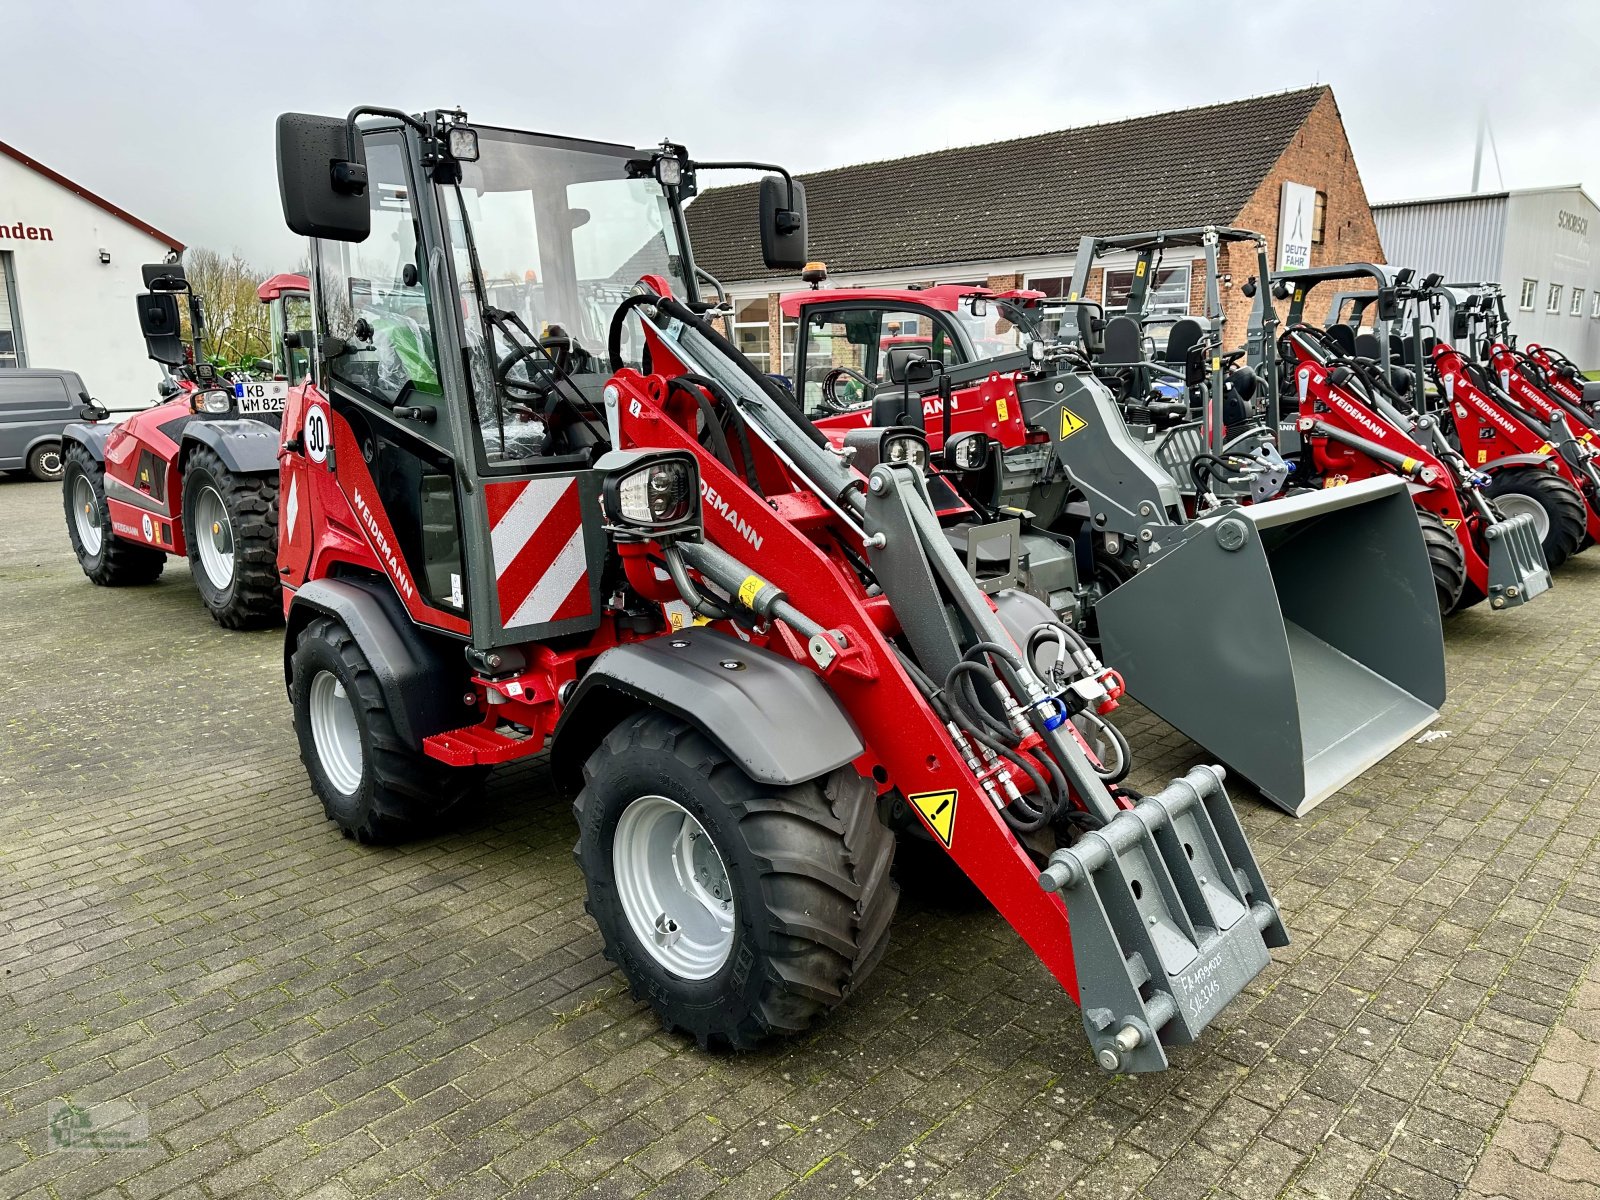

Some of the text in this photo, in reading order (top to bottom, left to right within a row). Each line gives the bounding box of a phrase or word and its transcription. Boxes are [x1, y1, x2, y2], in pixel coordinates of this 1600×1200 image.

[1285, 244, 1308, 256] DEUTZ
[1286, 255, 1305, 267] FAHR
[246, 385, 264, 398] KB
[242, 399, 260, 412] WM
[1328, 390, 1387, 439] WEIDEMANN
[1468, 392, 1517, 434] WEIDEMANN
[309, 415, 325, 453] 30
[354, 487, 413, 599] WEIDEMANN
